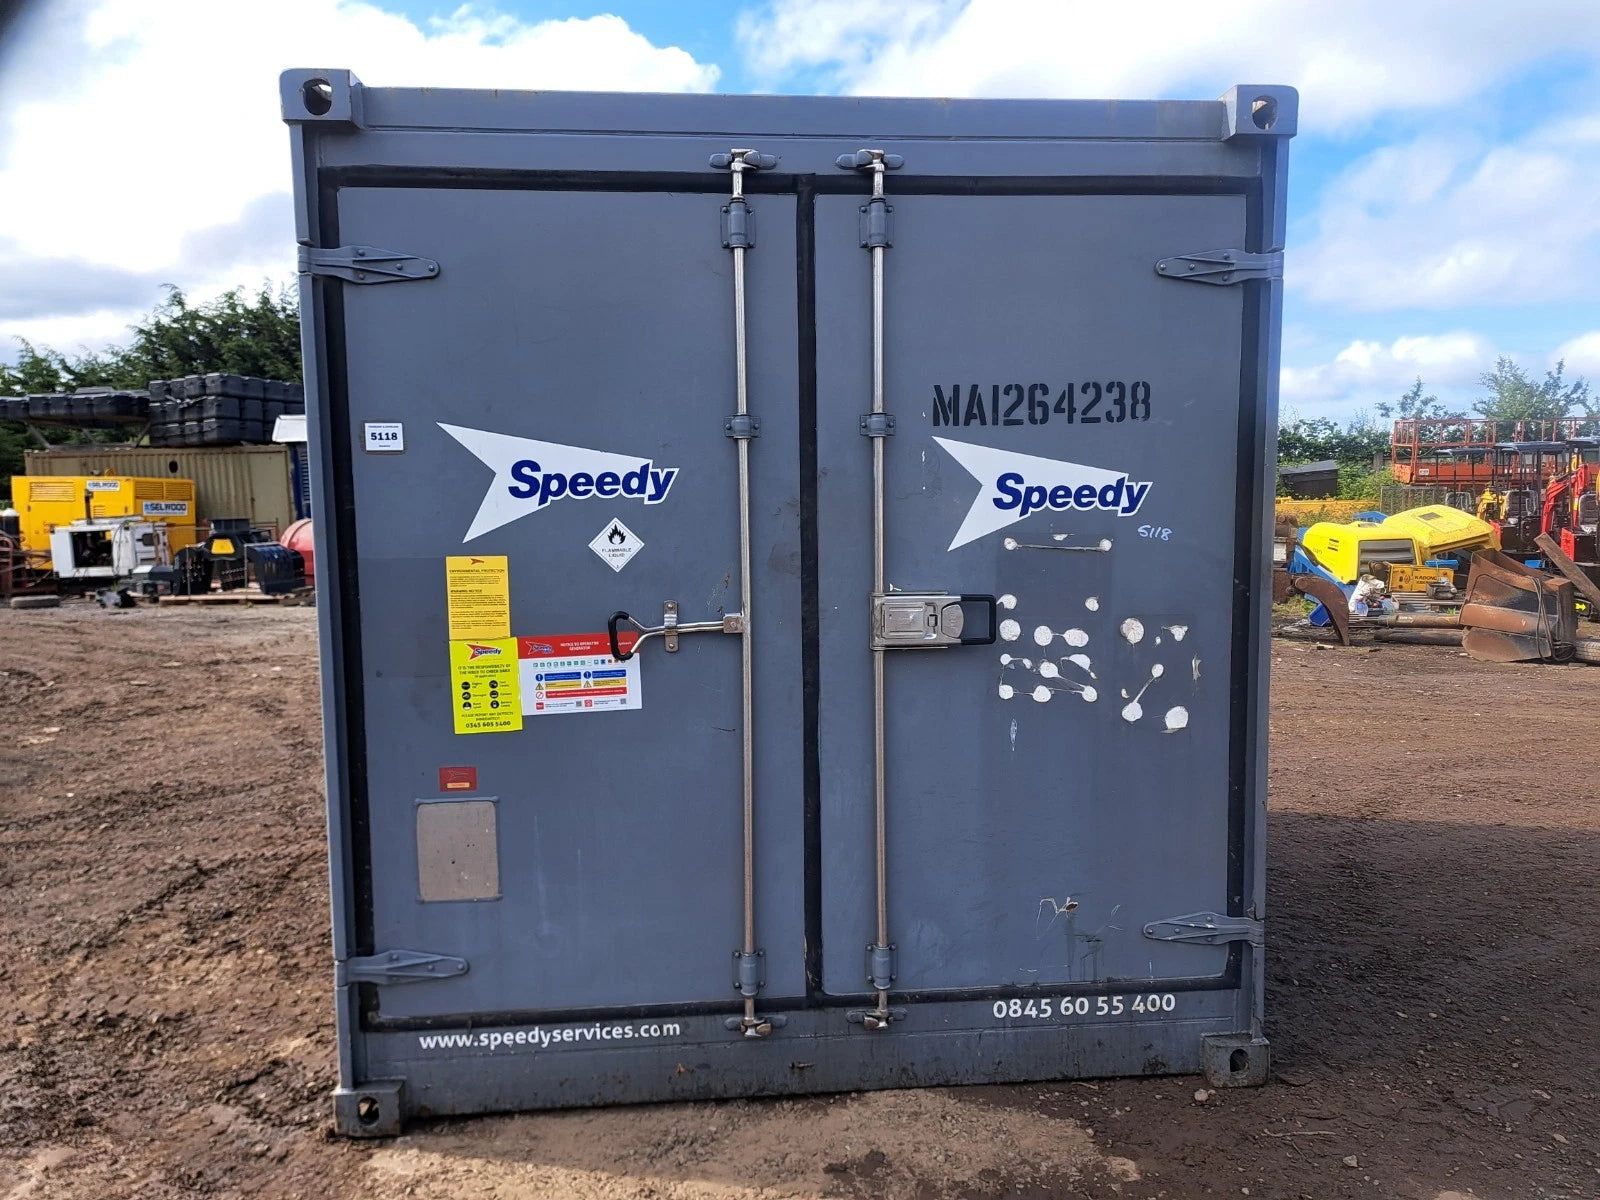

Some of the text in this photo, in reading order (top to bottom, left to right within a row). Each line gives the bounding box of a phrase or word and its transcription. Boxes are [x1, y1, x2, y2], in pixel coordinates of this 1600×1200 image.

[370, 432, 398, 441] 5118
[508, 460, 676, 507] Speedy
[992, 472, 1149, 518] Speedy
[150, 503, 187, 511] SELWOOD
[475, 647, 502, 656] Speedy
[992, 993, 1176, 1019] 0845 60 55 400
[419, 1020, 681, 1050] www.speedyservices.com
